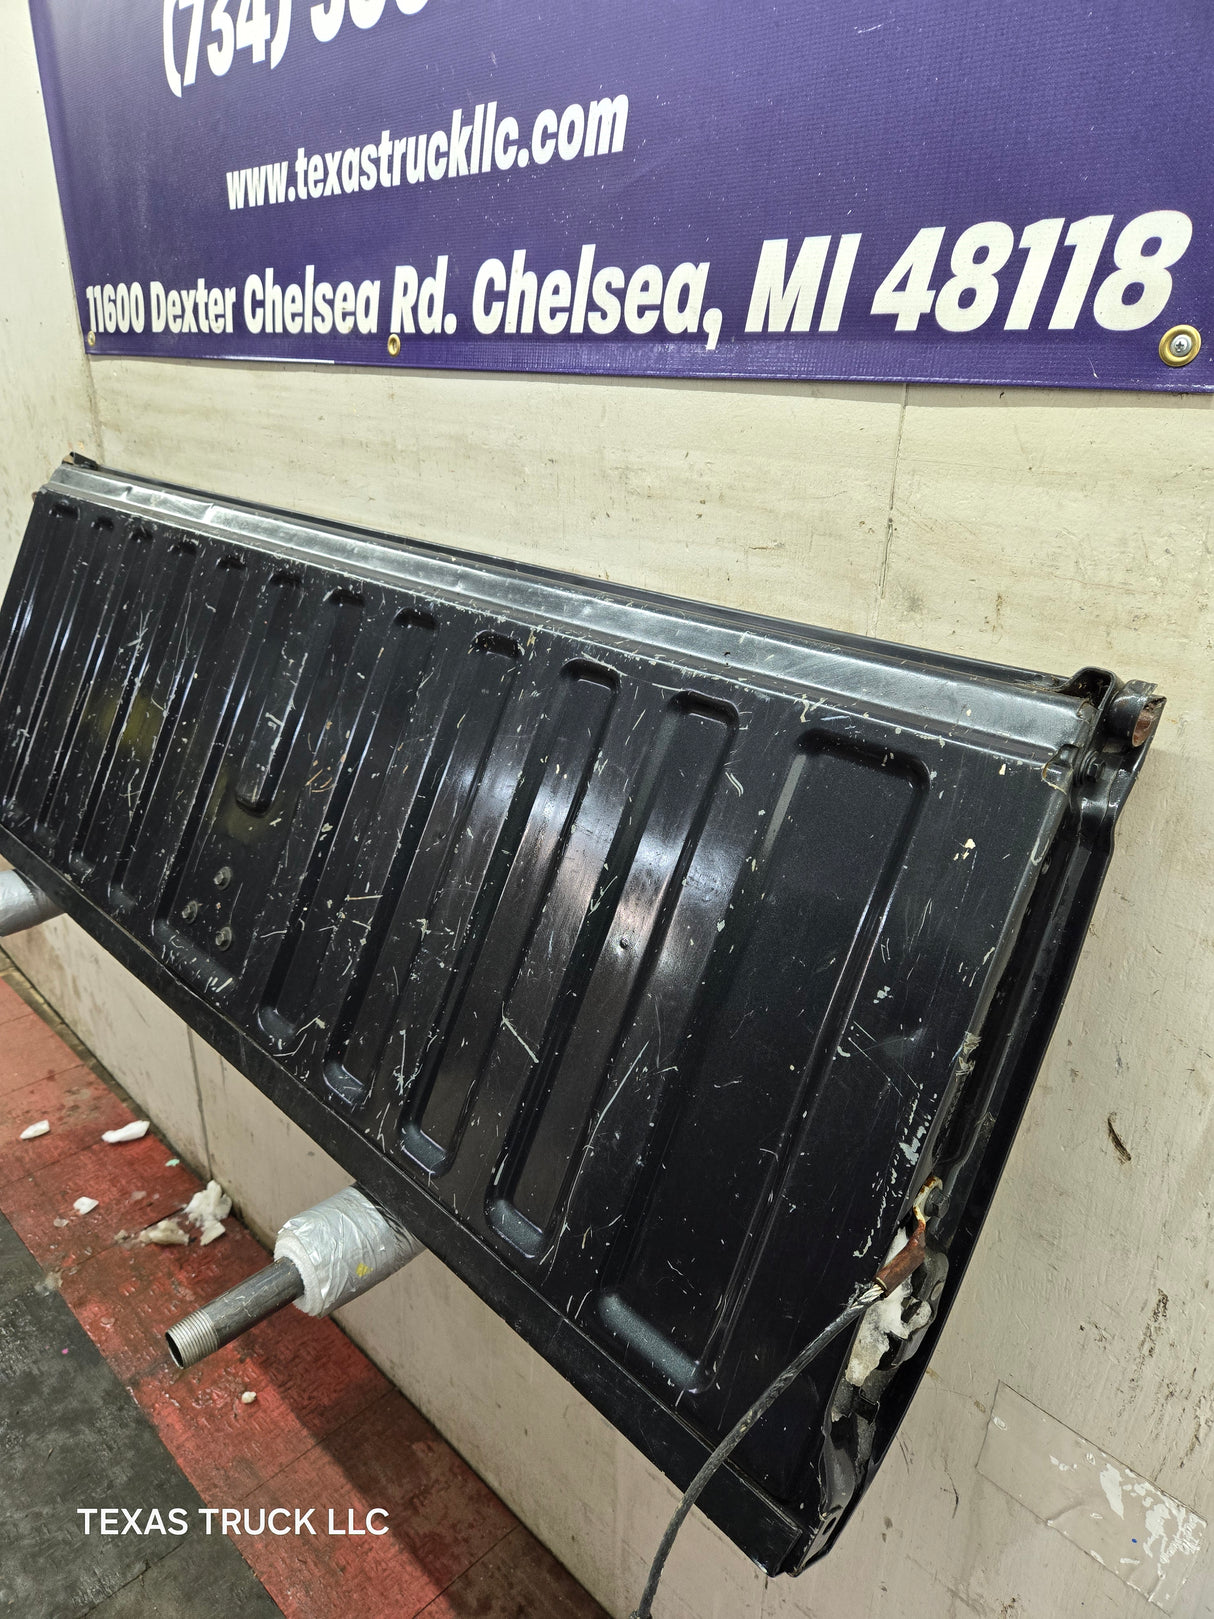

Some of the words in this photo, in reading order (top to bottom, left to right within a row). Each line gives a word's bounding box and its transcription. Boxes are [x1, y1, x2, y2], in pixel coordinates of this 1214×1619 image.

[226, 94, 629, 210] www.texastruckllc.com
[86, 281, 145, 334] 11600
[150, 278, 236, 334] Dexter
[243, 264, 381, 335] Chelsea
[390, 254, 457, 335] Rd.
[472, 243, 723, 353] Chelsea,
[744, 232, 863, 333] MI
[870, 209, 1193, 333] 48118
